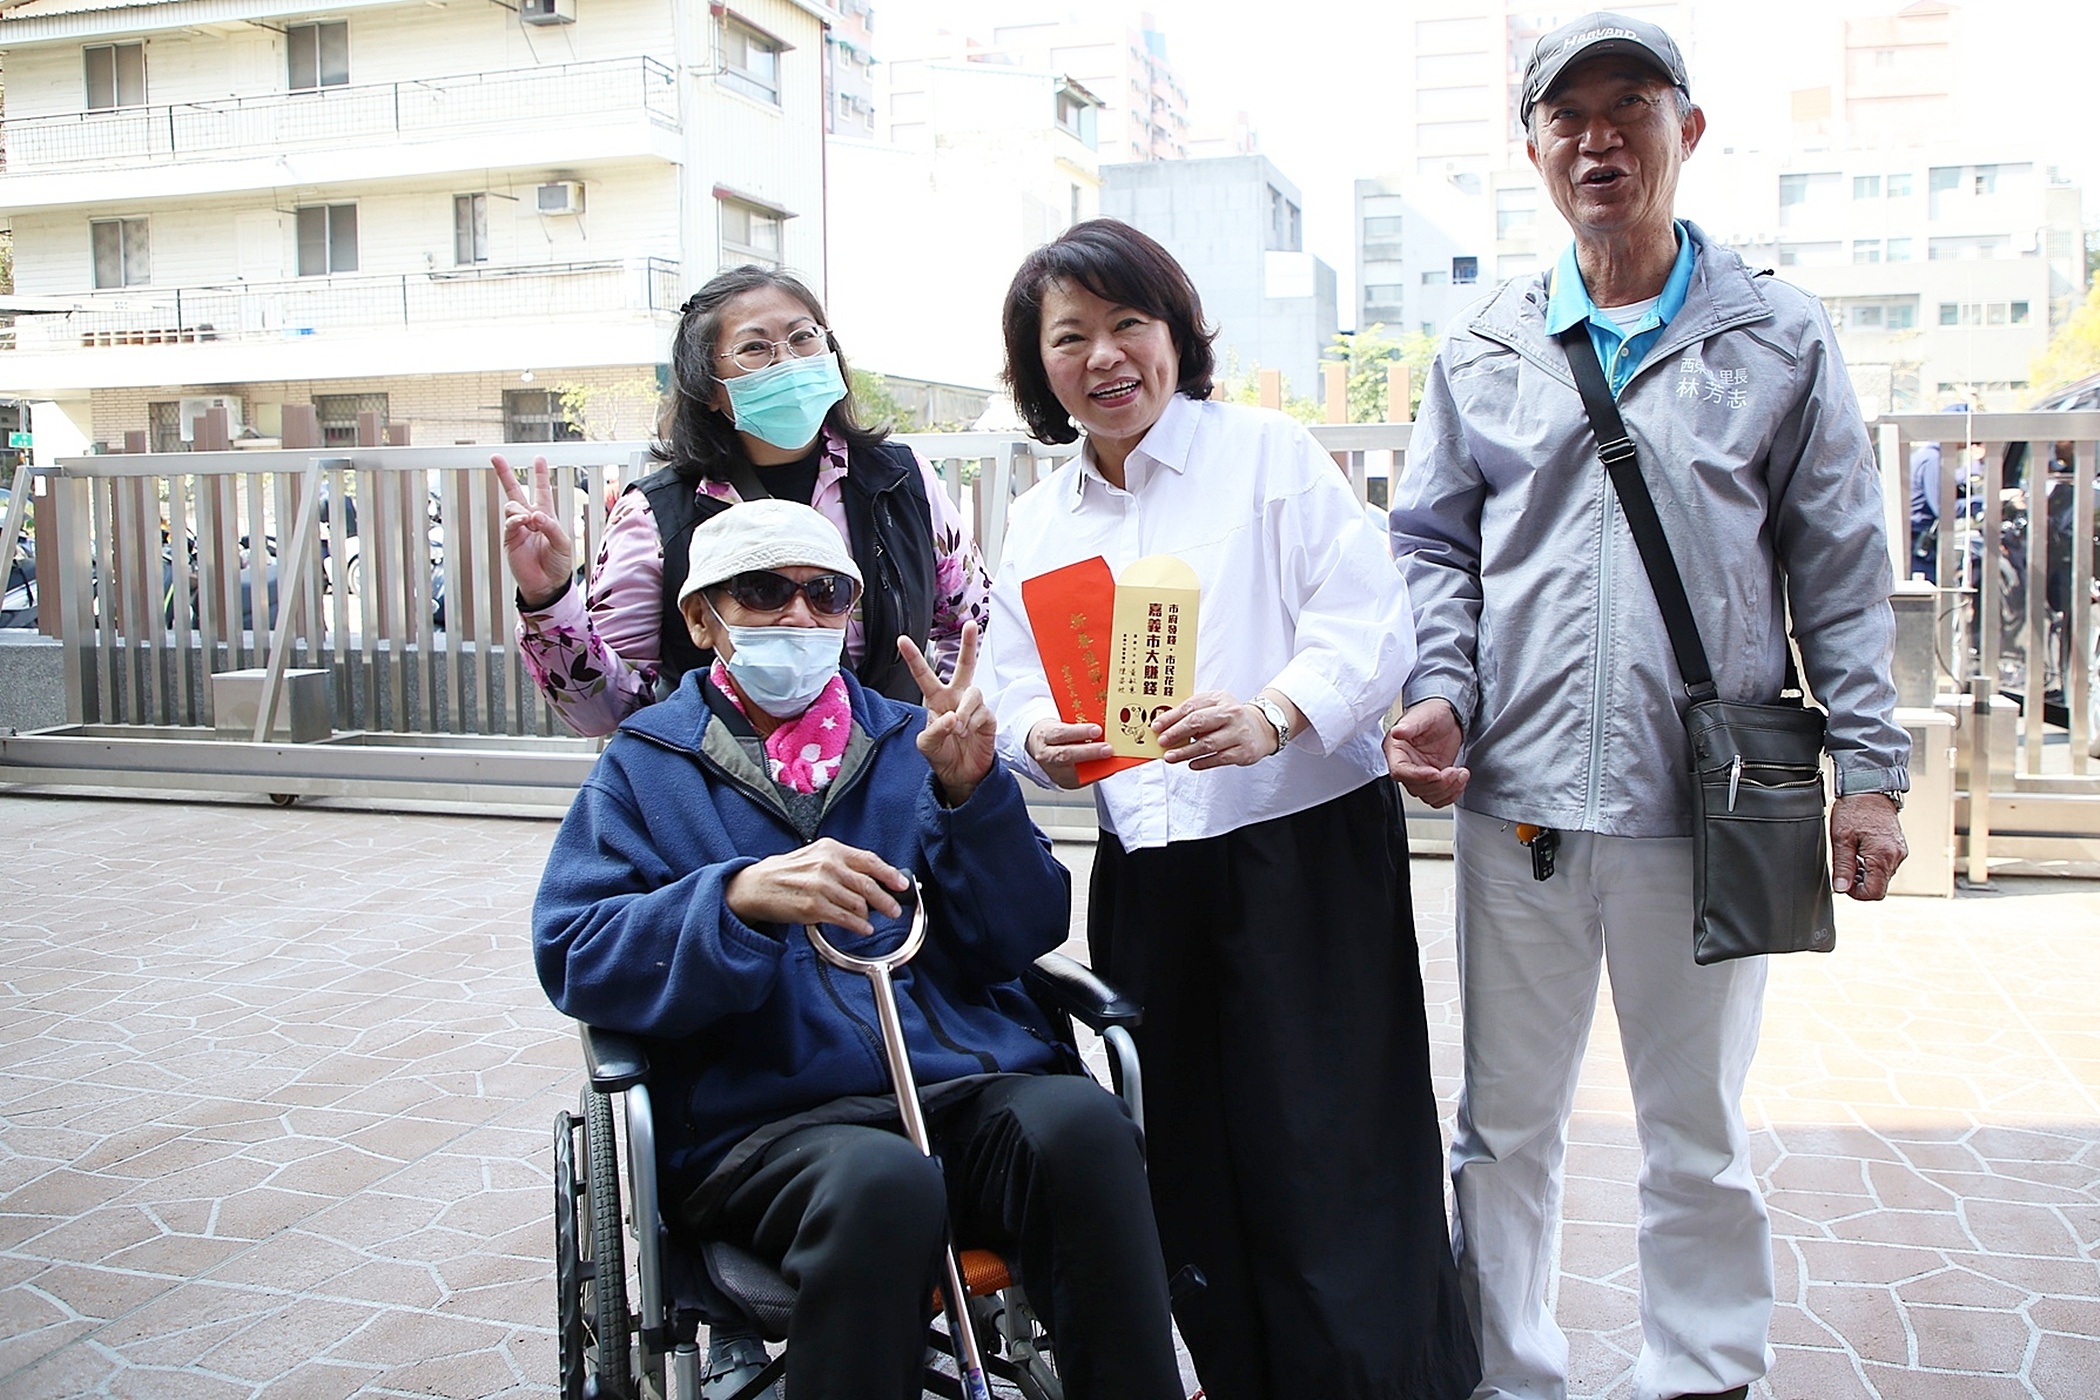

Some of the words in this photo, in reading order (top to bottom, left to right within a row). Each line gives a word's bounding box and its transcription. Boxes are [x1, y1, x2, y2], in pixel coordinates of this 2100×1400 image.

[1675, 377, 1748, 409] 林芳志
[1143, 602, 1163, 696] 嘉義市大賺錢
